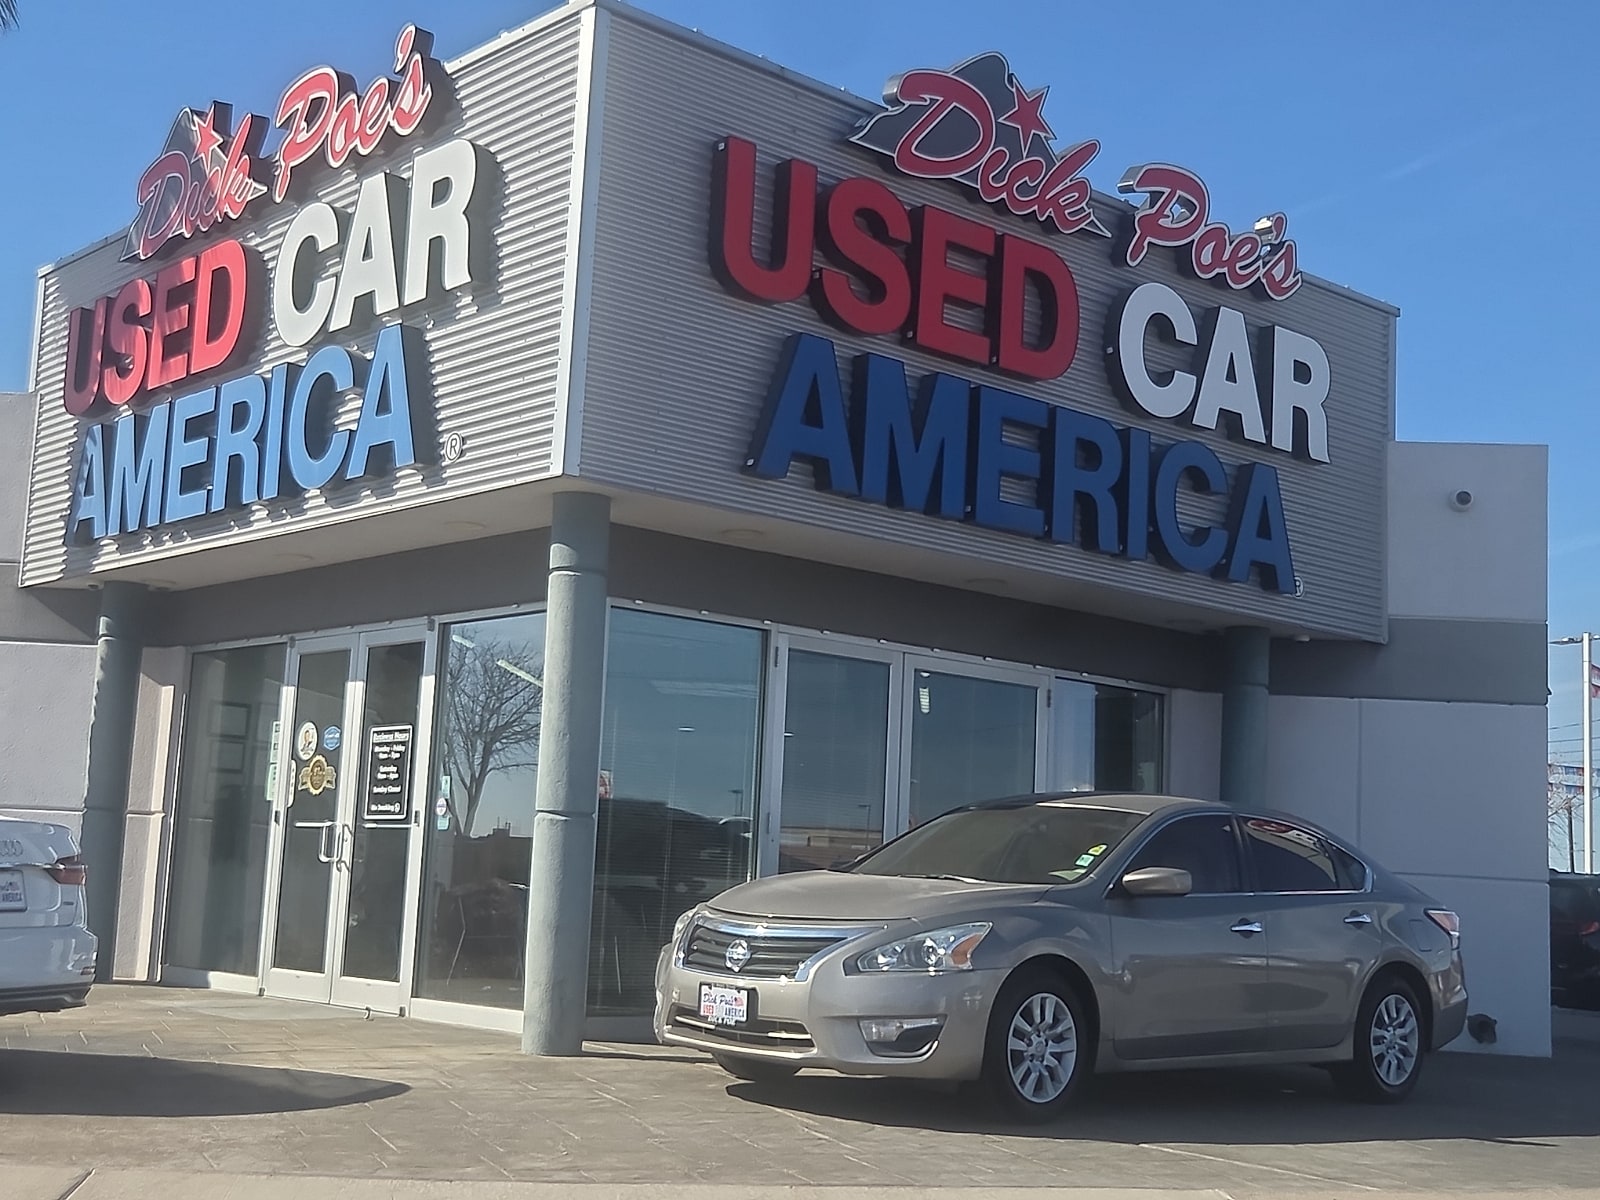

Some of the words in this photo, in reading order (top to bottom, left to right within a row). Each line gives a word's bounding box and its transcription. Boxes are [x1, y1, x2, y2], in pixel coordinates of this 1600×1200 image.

[138, 115, 256, 260] Dick
[273, 24, 431, 203] Poe's
[892, 68, 1101, 235] Dick
[1122, 163, 1302, 301] Poe's
[64, 239, 247, 416] USED
[273, 138, 478, 347] CAR
[714, 136, 1080, 381] USED
[1116, 282, 1331, 463] CAR
[72, 324, 416, 539] AMERICA
[750, 332, 1296, 595] AMERICA
